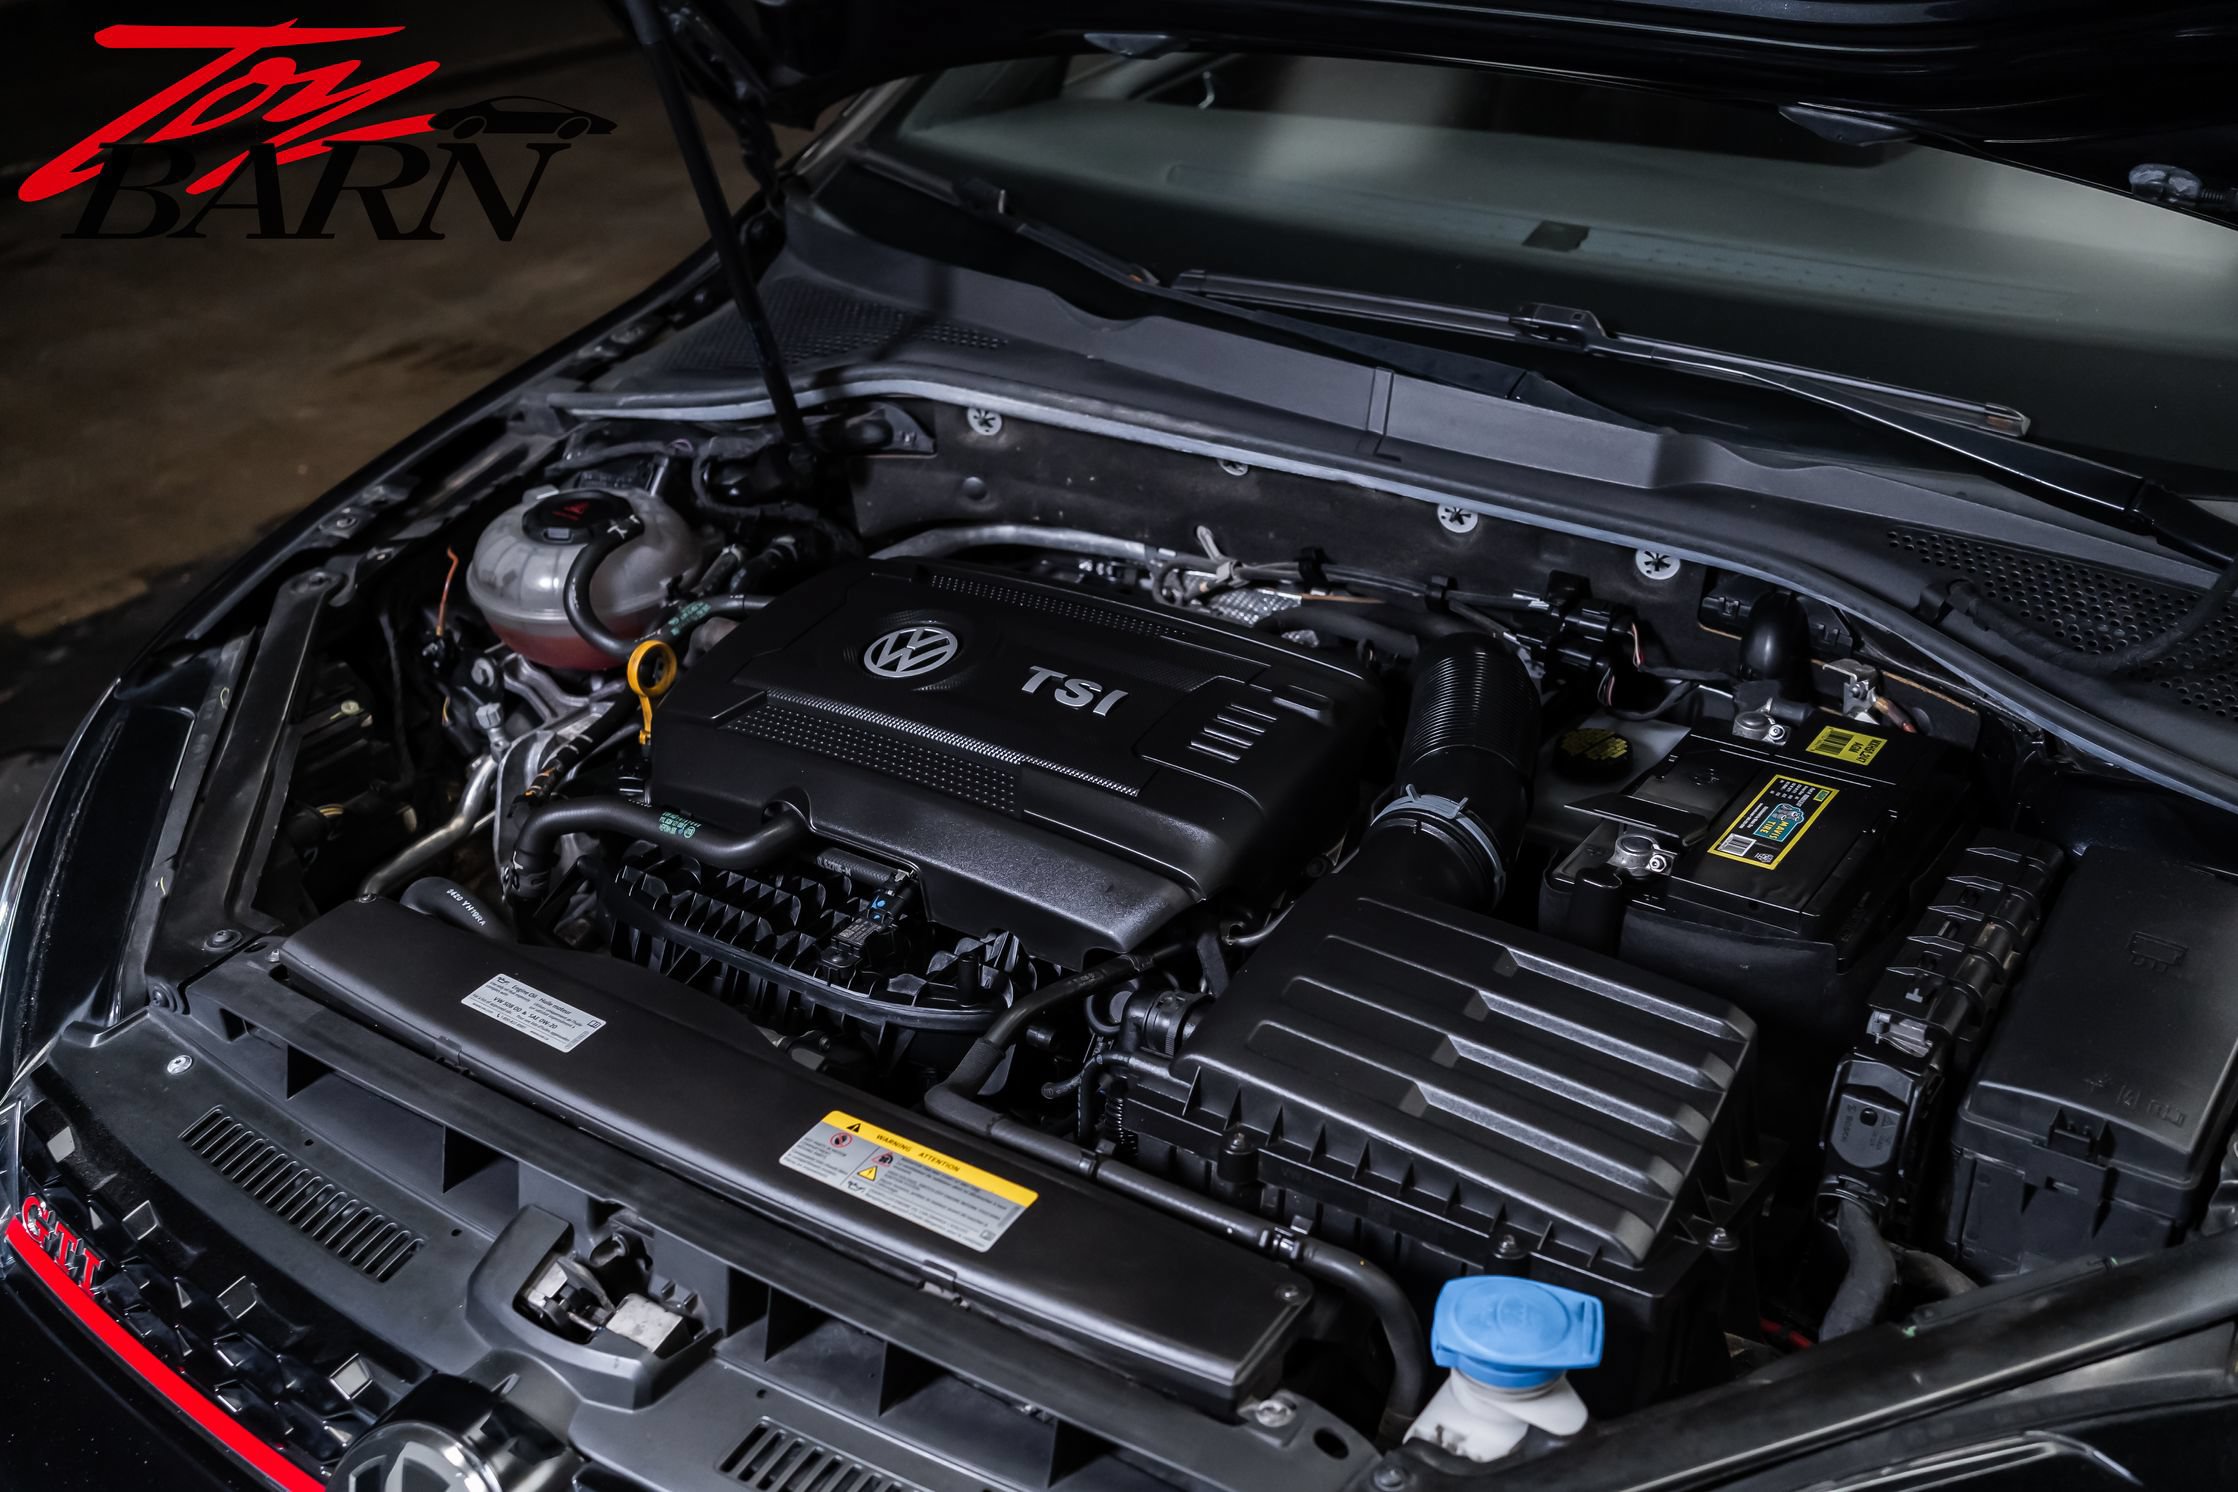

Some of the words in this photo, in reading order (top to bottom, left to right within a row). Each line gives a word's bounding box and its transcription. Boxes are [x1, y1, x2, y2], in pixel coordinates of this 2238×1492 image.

[1021, 666, 1129, 717] TSI
[1759, 820, 1776, 833] TIRE
[1768, 821, 1789, 838] MAVIS
[511, 985, 530, 996] Engine
[538, 997, 554, 1006] Huile
[551, 1004, 571, 1014] moteur
[875, 1134, 912, 1151] WARNING
[917, 1151, 960, 1171] ATTENTION
[22, 1193, 106, 1295] GTI
